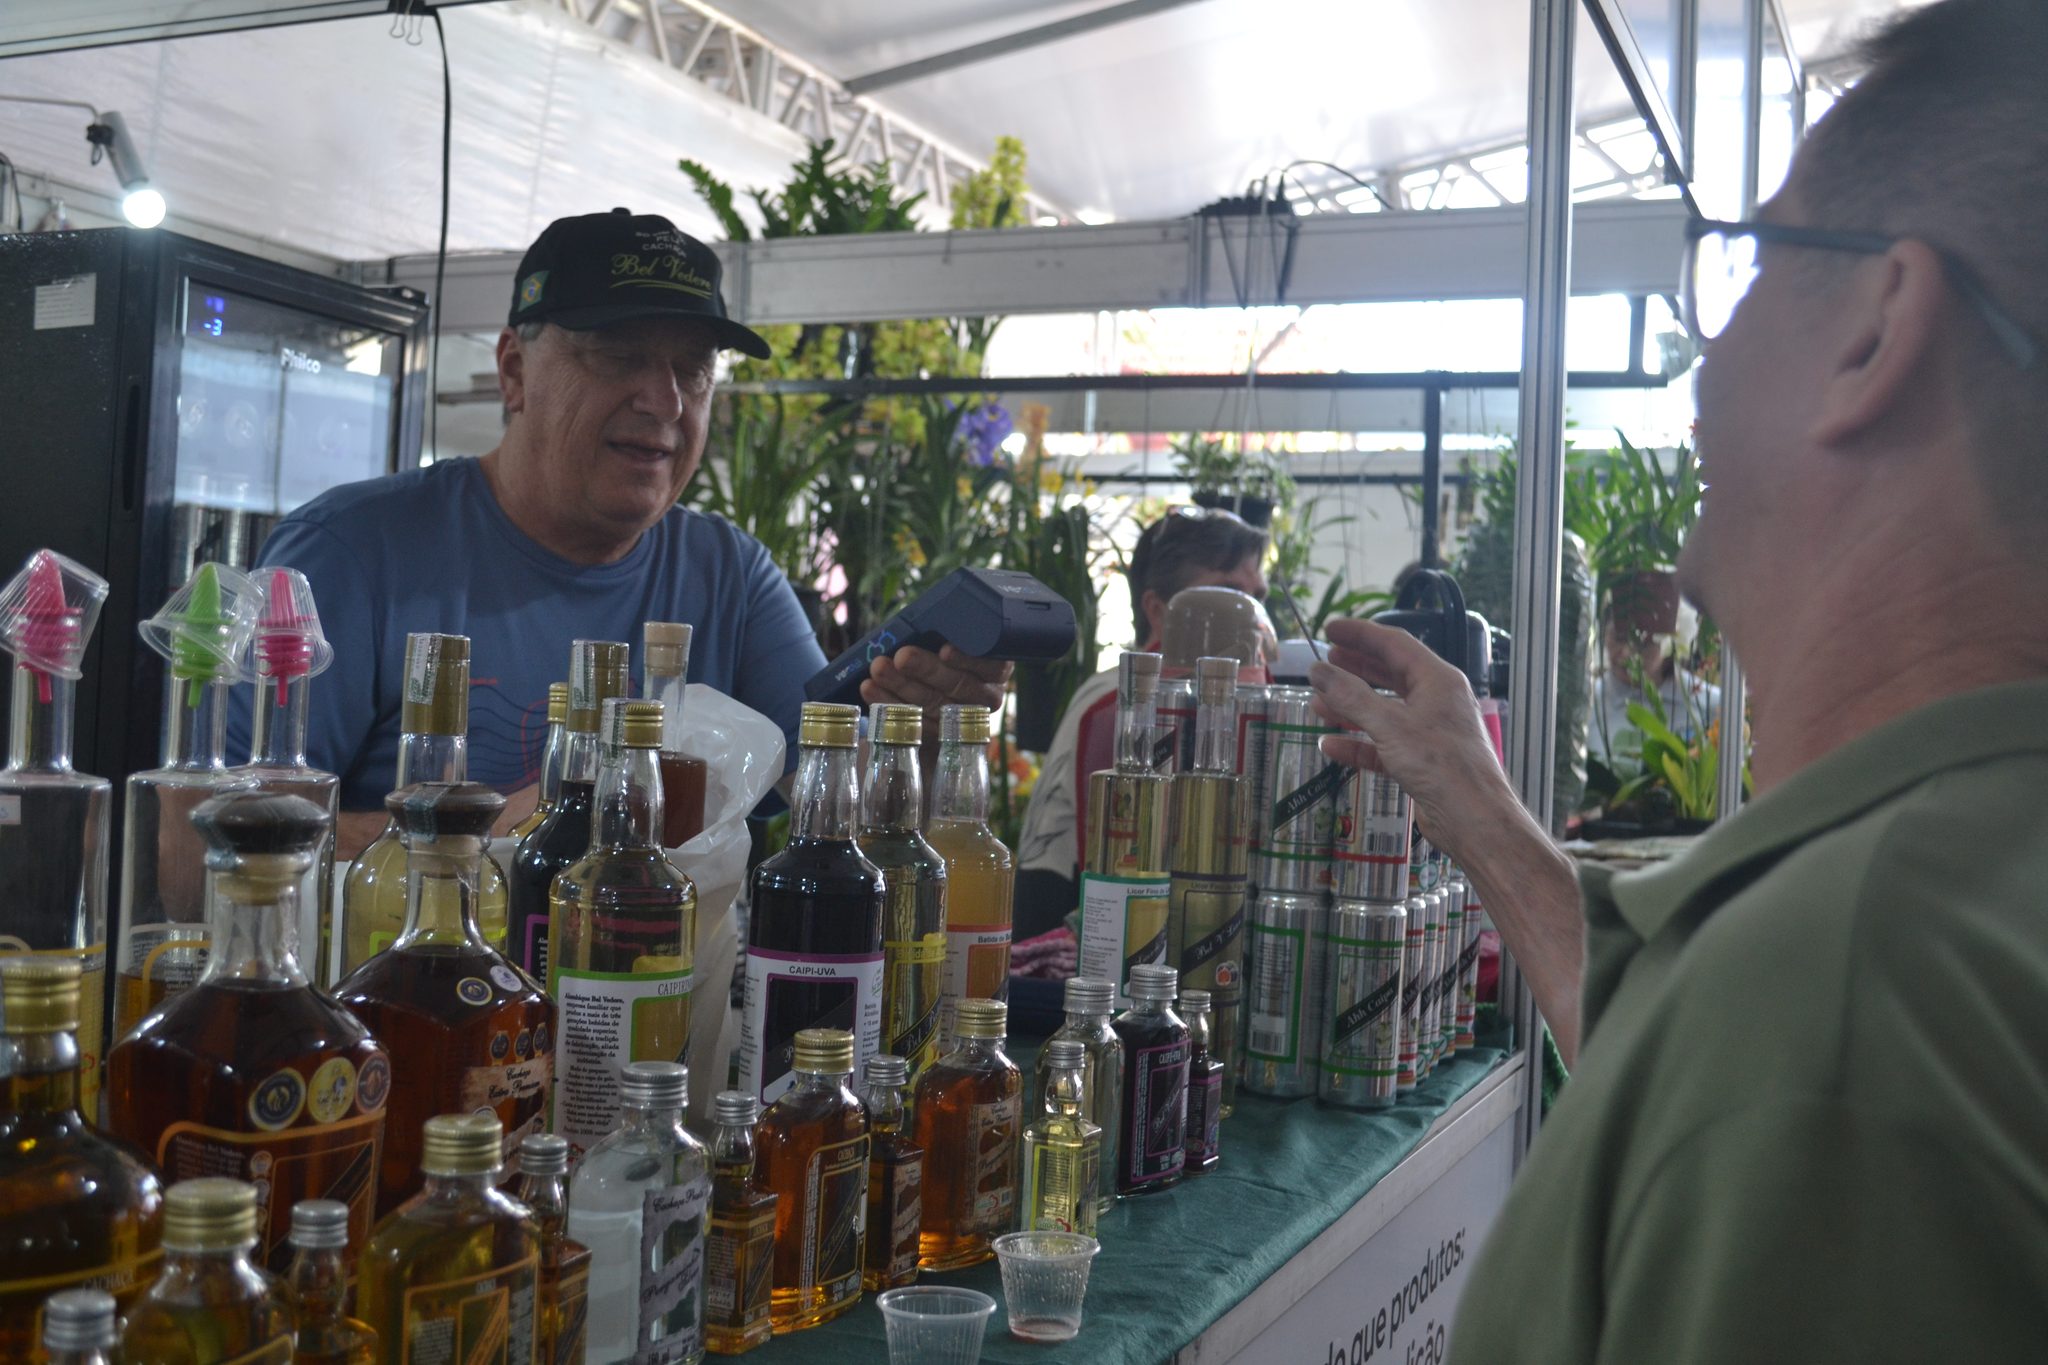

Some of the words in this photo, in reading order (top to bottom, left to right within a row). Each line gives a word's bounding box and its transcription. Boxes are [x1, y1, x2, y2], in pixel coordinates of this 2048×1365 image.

[611, 254, 660, 275] Bel
[282, 347, 321, 374] Philco
[789, 965, 836, 976] CAIPI-UVA
[1346, 1009, 1366, 1029] Ahh
[1350, 1307, 1386, 1365] que
[1389, 1227, 1466, 1350] produtos:
